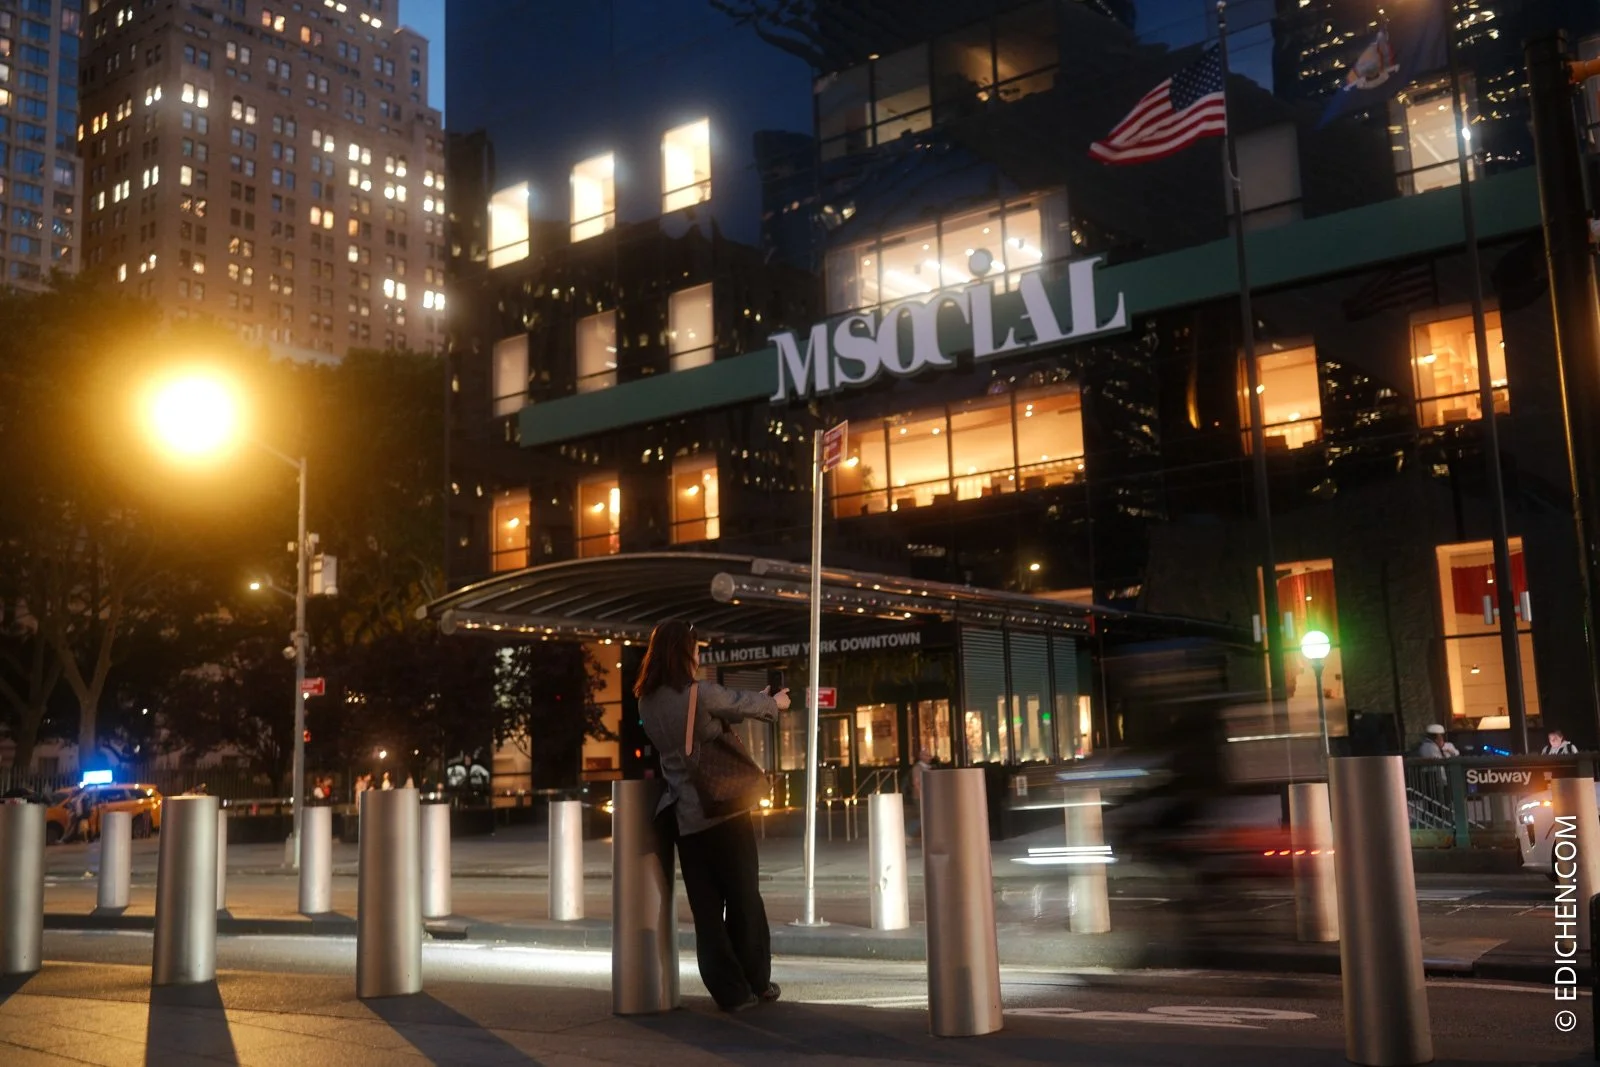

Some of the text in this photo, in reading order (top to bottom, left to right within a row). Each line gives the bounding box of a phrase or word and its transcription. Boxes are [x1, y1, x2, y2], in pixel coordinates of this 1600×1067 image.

[730, 646, 770, 662] HOTEL
[772, 643, 800, 658] NEW
[801, 640, 838, 655] YRK
[840, 631, 922, 651] DOWNTOWN
[1466, 769, 1532, 786] Subway
